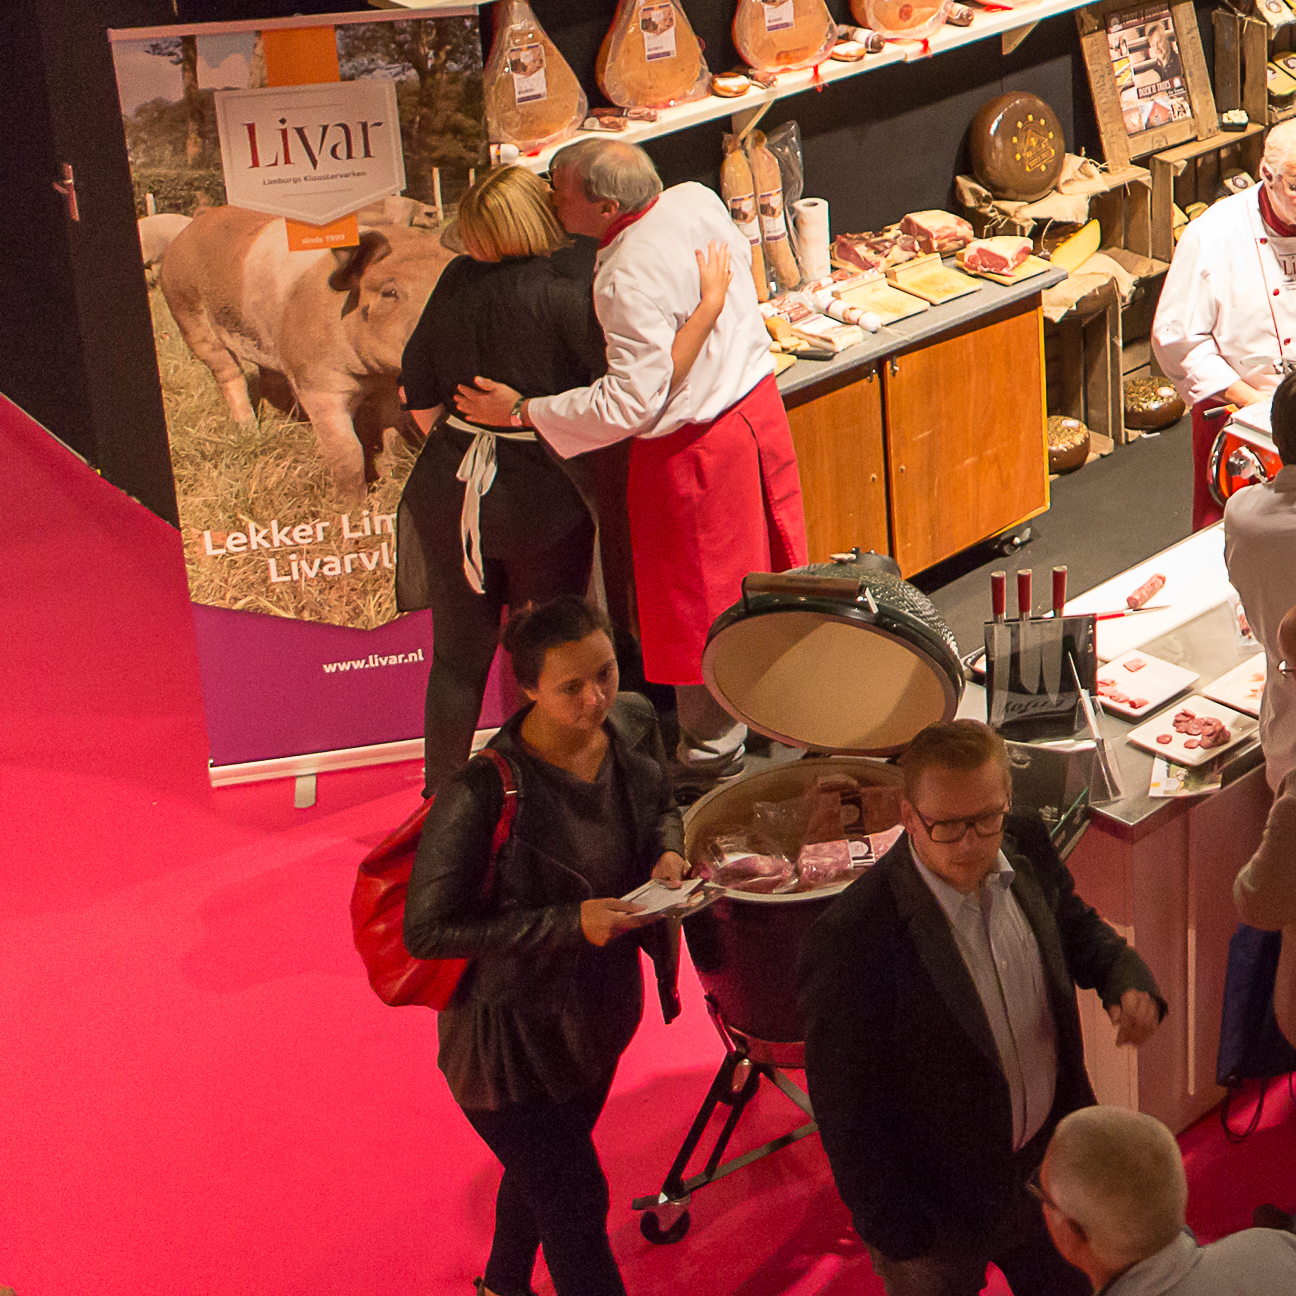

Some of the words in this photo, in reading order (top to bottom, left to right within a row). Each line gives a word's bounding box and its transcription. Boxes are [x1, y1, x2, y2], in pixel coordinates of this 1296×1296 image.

[242, 117, 383, 171] Livar
[262, 174, 302, 186] Limburgs
[304, 170, 367, 183] Kloostervarken
[205, 519, 329, 556] Lekker
[323, 649, 424, 673] www.livar.nl
